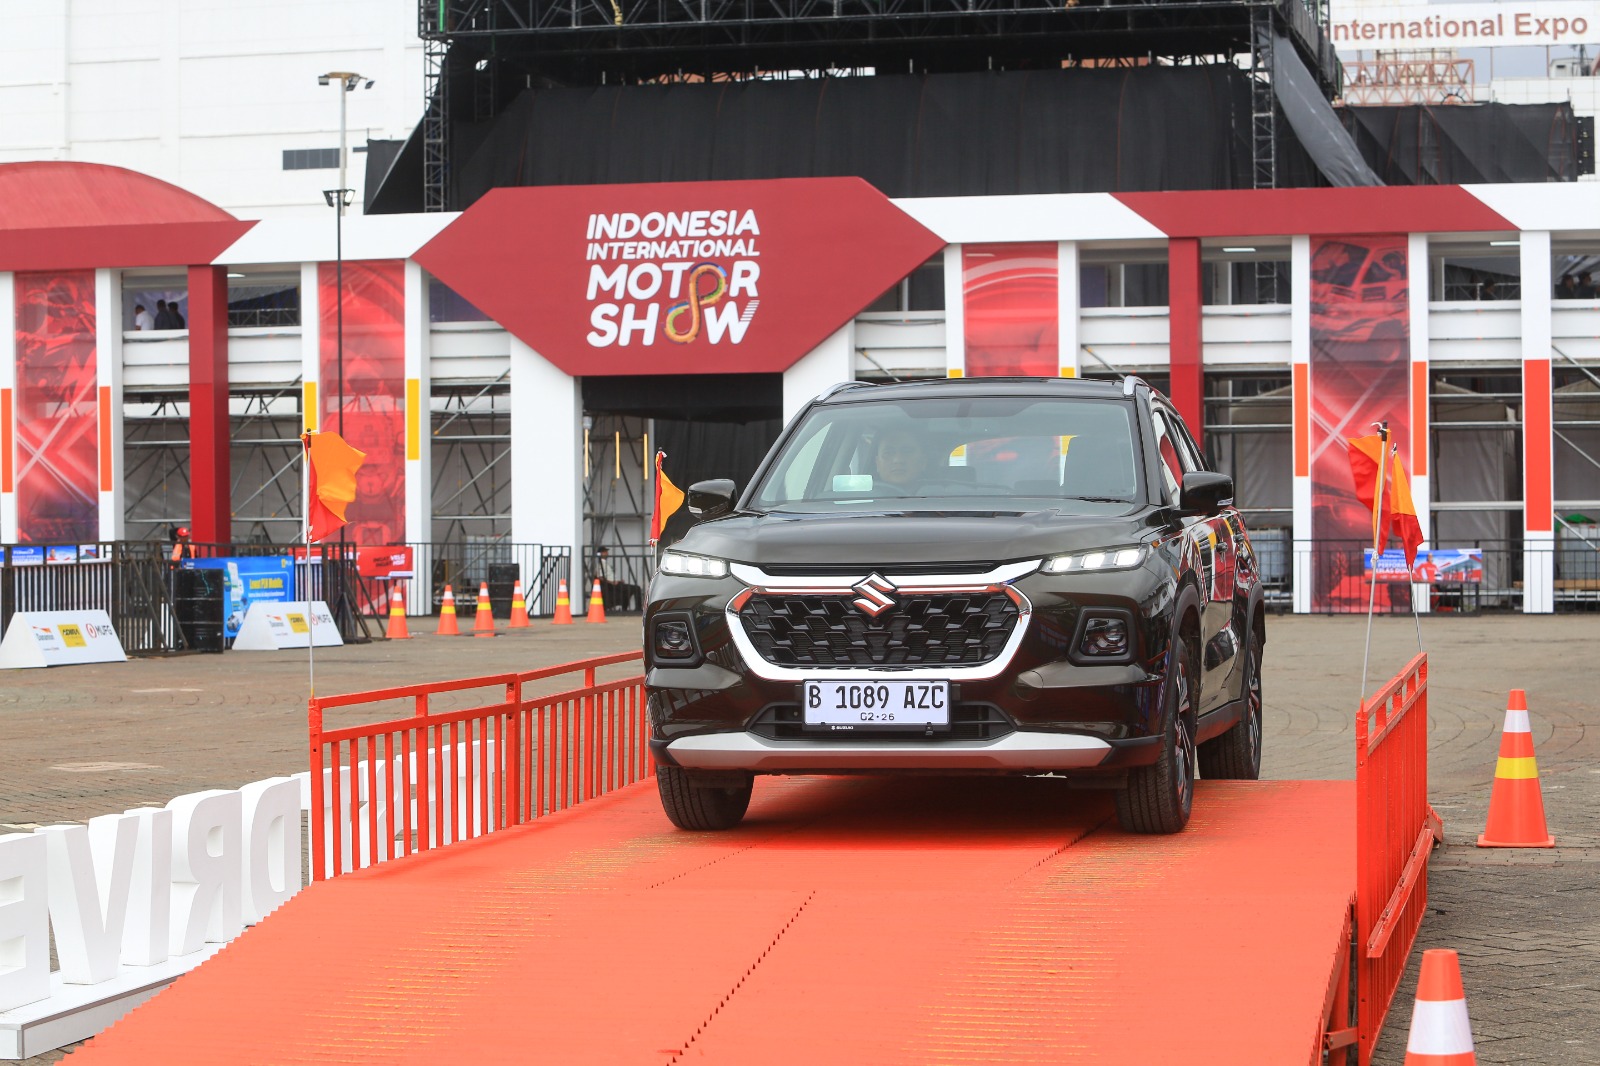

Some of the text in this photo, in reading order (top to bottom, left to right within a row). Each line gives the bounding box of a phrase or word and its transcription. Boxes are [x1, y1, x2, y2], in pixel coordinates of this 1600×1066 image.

[1324, 12, 1588, 41] nternational Expo
[586, 209, 760, 240] INDONESIA
[586, 238, 760, 260] INTERNATIONAL
[95, 625, 113, 636] MUFG
[808, 685, 944, 709] B 1089 AZC
